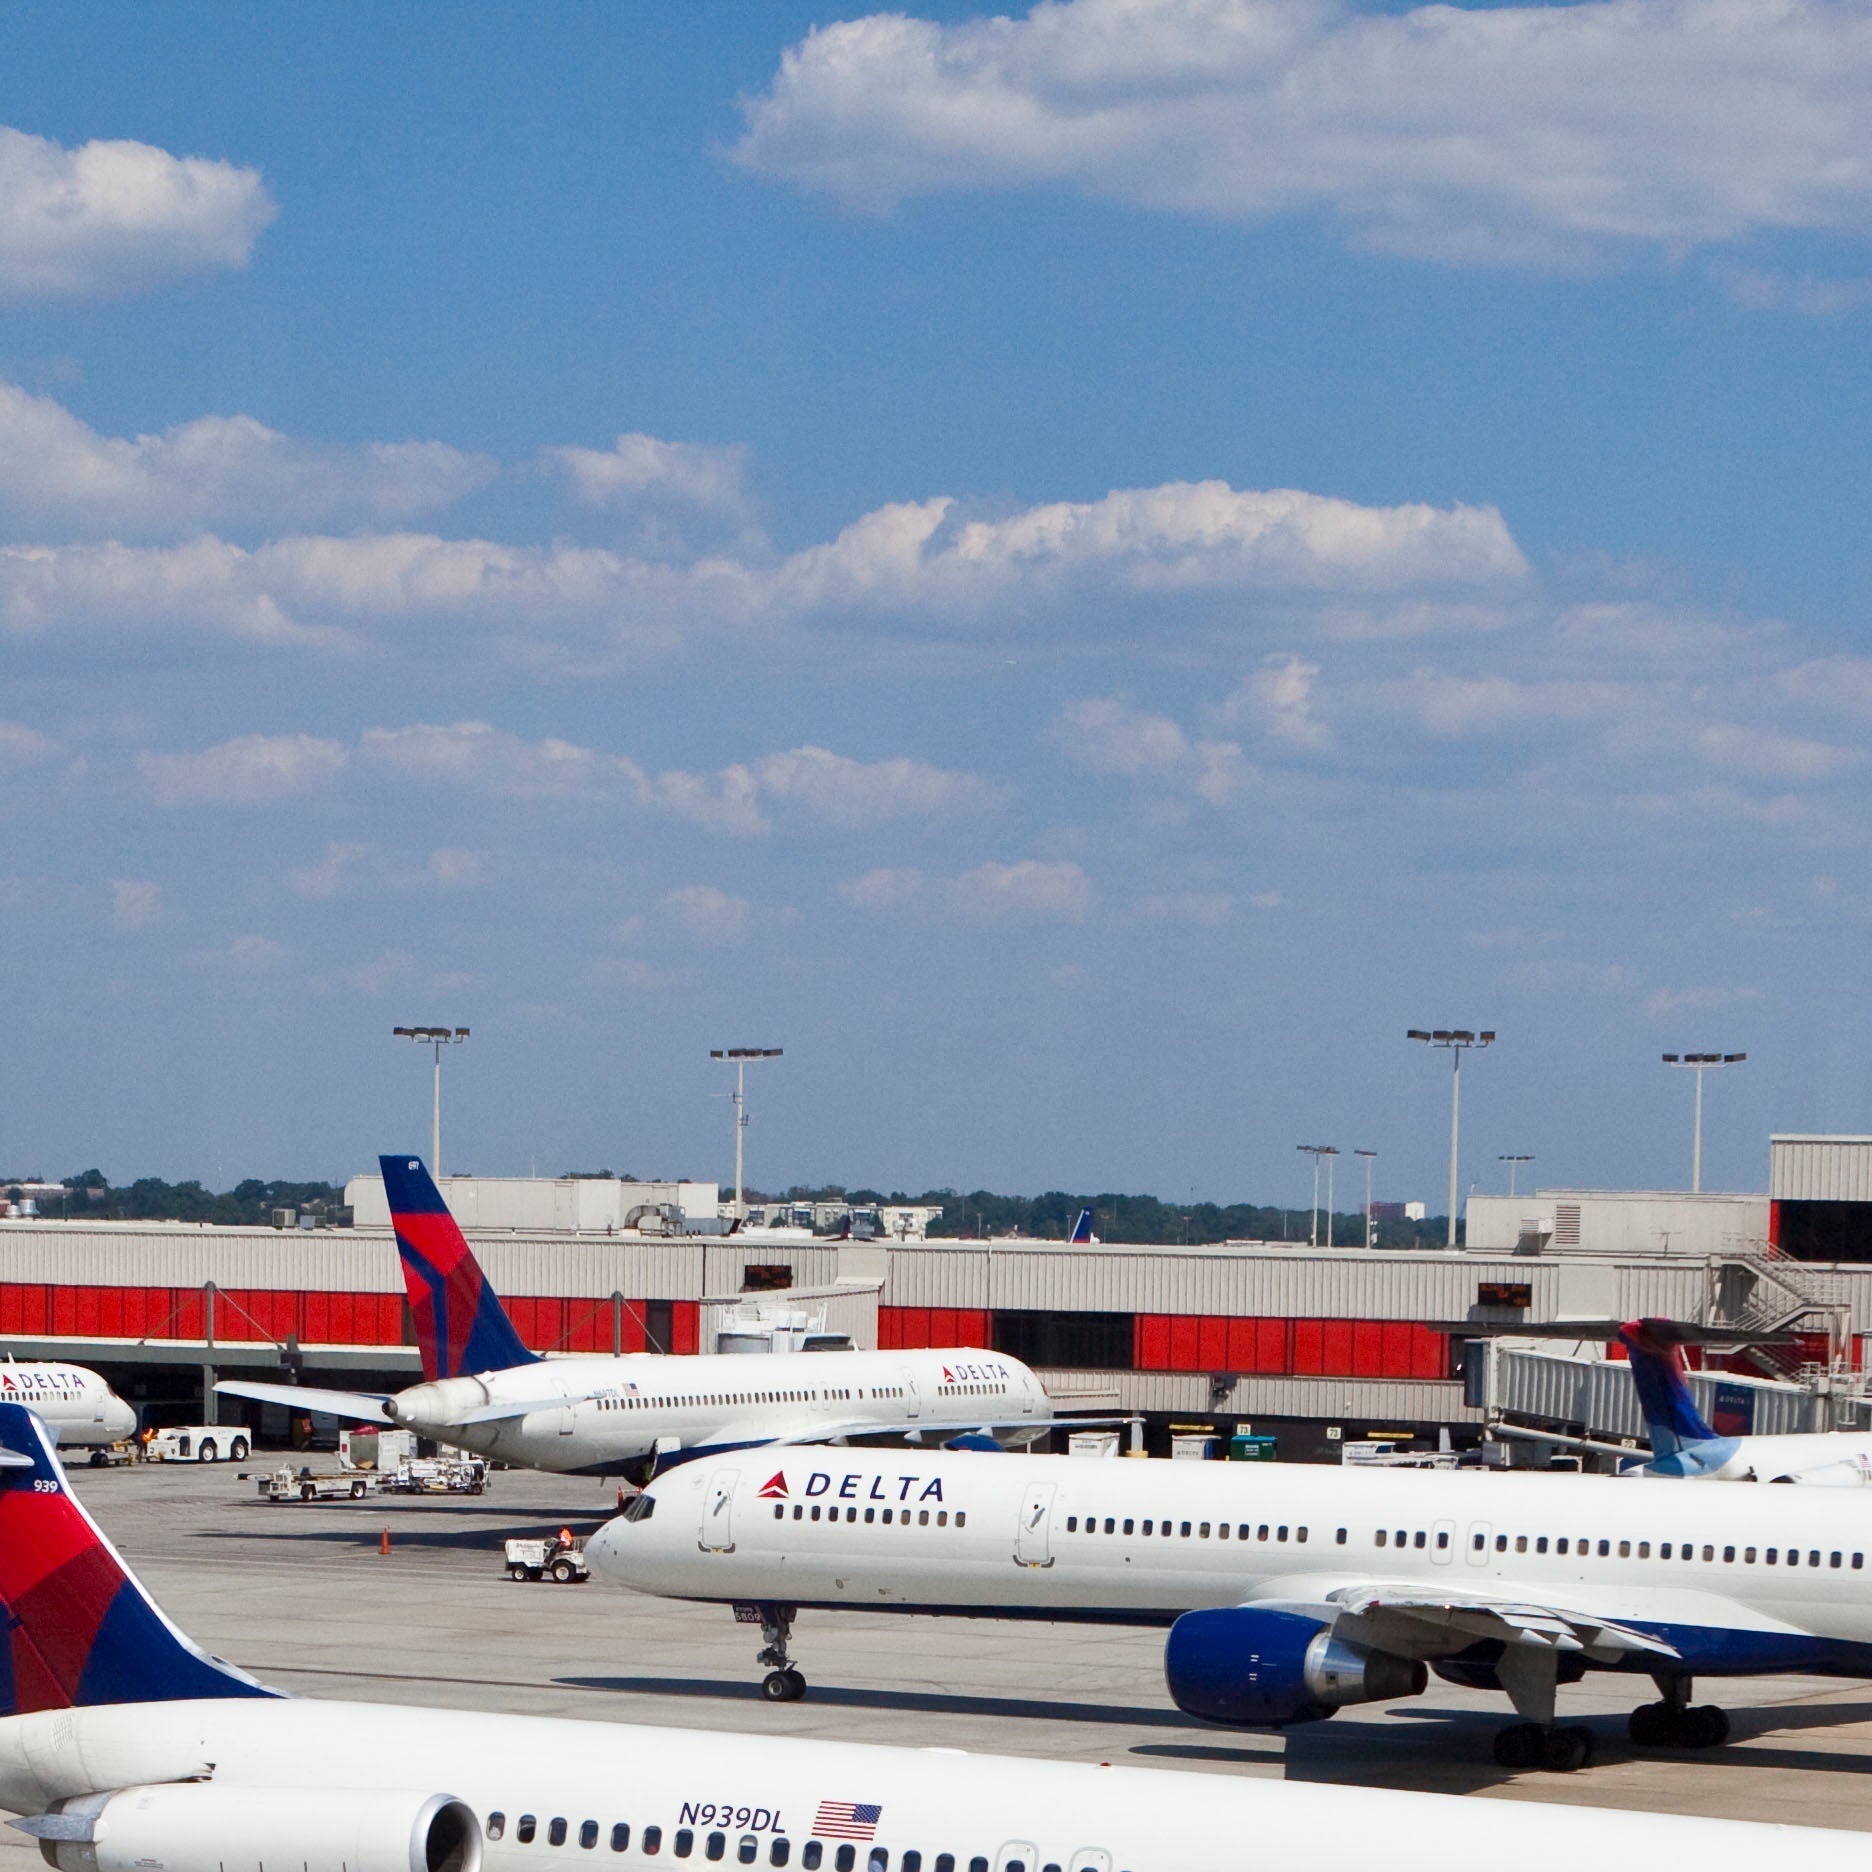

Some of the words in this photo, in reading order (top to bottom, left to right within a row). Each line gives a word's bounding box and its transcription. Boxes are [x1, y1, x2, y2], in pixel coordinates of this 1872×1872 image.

[956, 1364, 1009, 1380] DELTA
[18, 1373, 85, 1389] DELTA
[34, 1479, 58, 1493] 939
[805, 1472, 943, 1502] DELTA
[679, 1802, 785, 1834] N939DL
